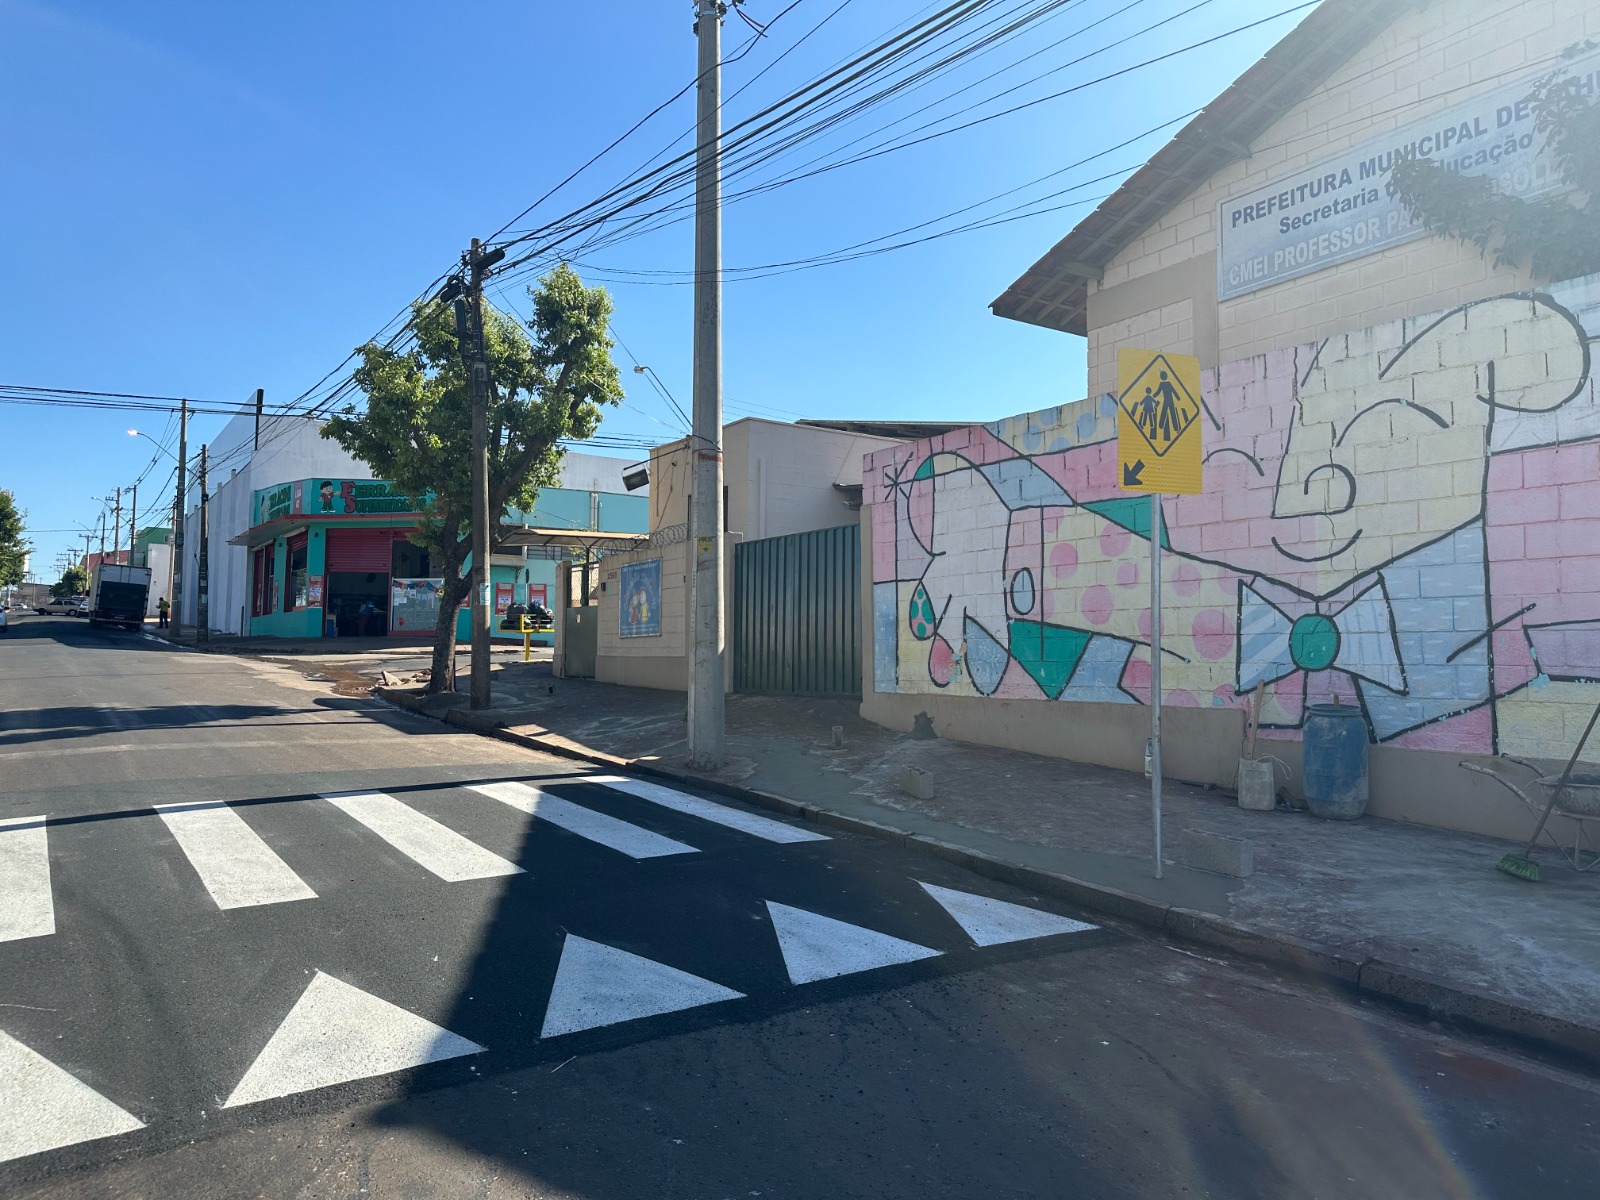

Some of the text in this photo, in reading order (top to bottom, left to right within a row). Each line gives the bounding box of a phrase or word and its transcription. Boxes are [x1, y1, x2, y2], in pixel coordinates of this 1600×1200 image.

[1231, 99, 1530, 229] PREFEITURA MUNICIPAL DE
[1279, 187, 1379, 234] Secretaria
[1229, 255, 1268, 286] CMEI
[1274, 217, 1380, 271] PROFESSOR
